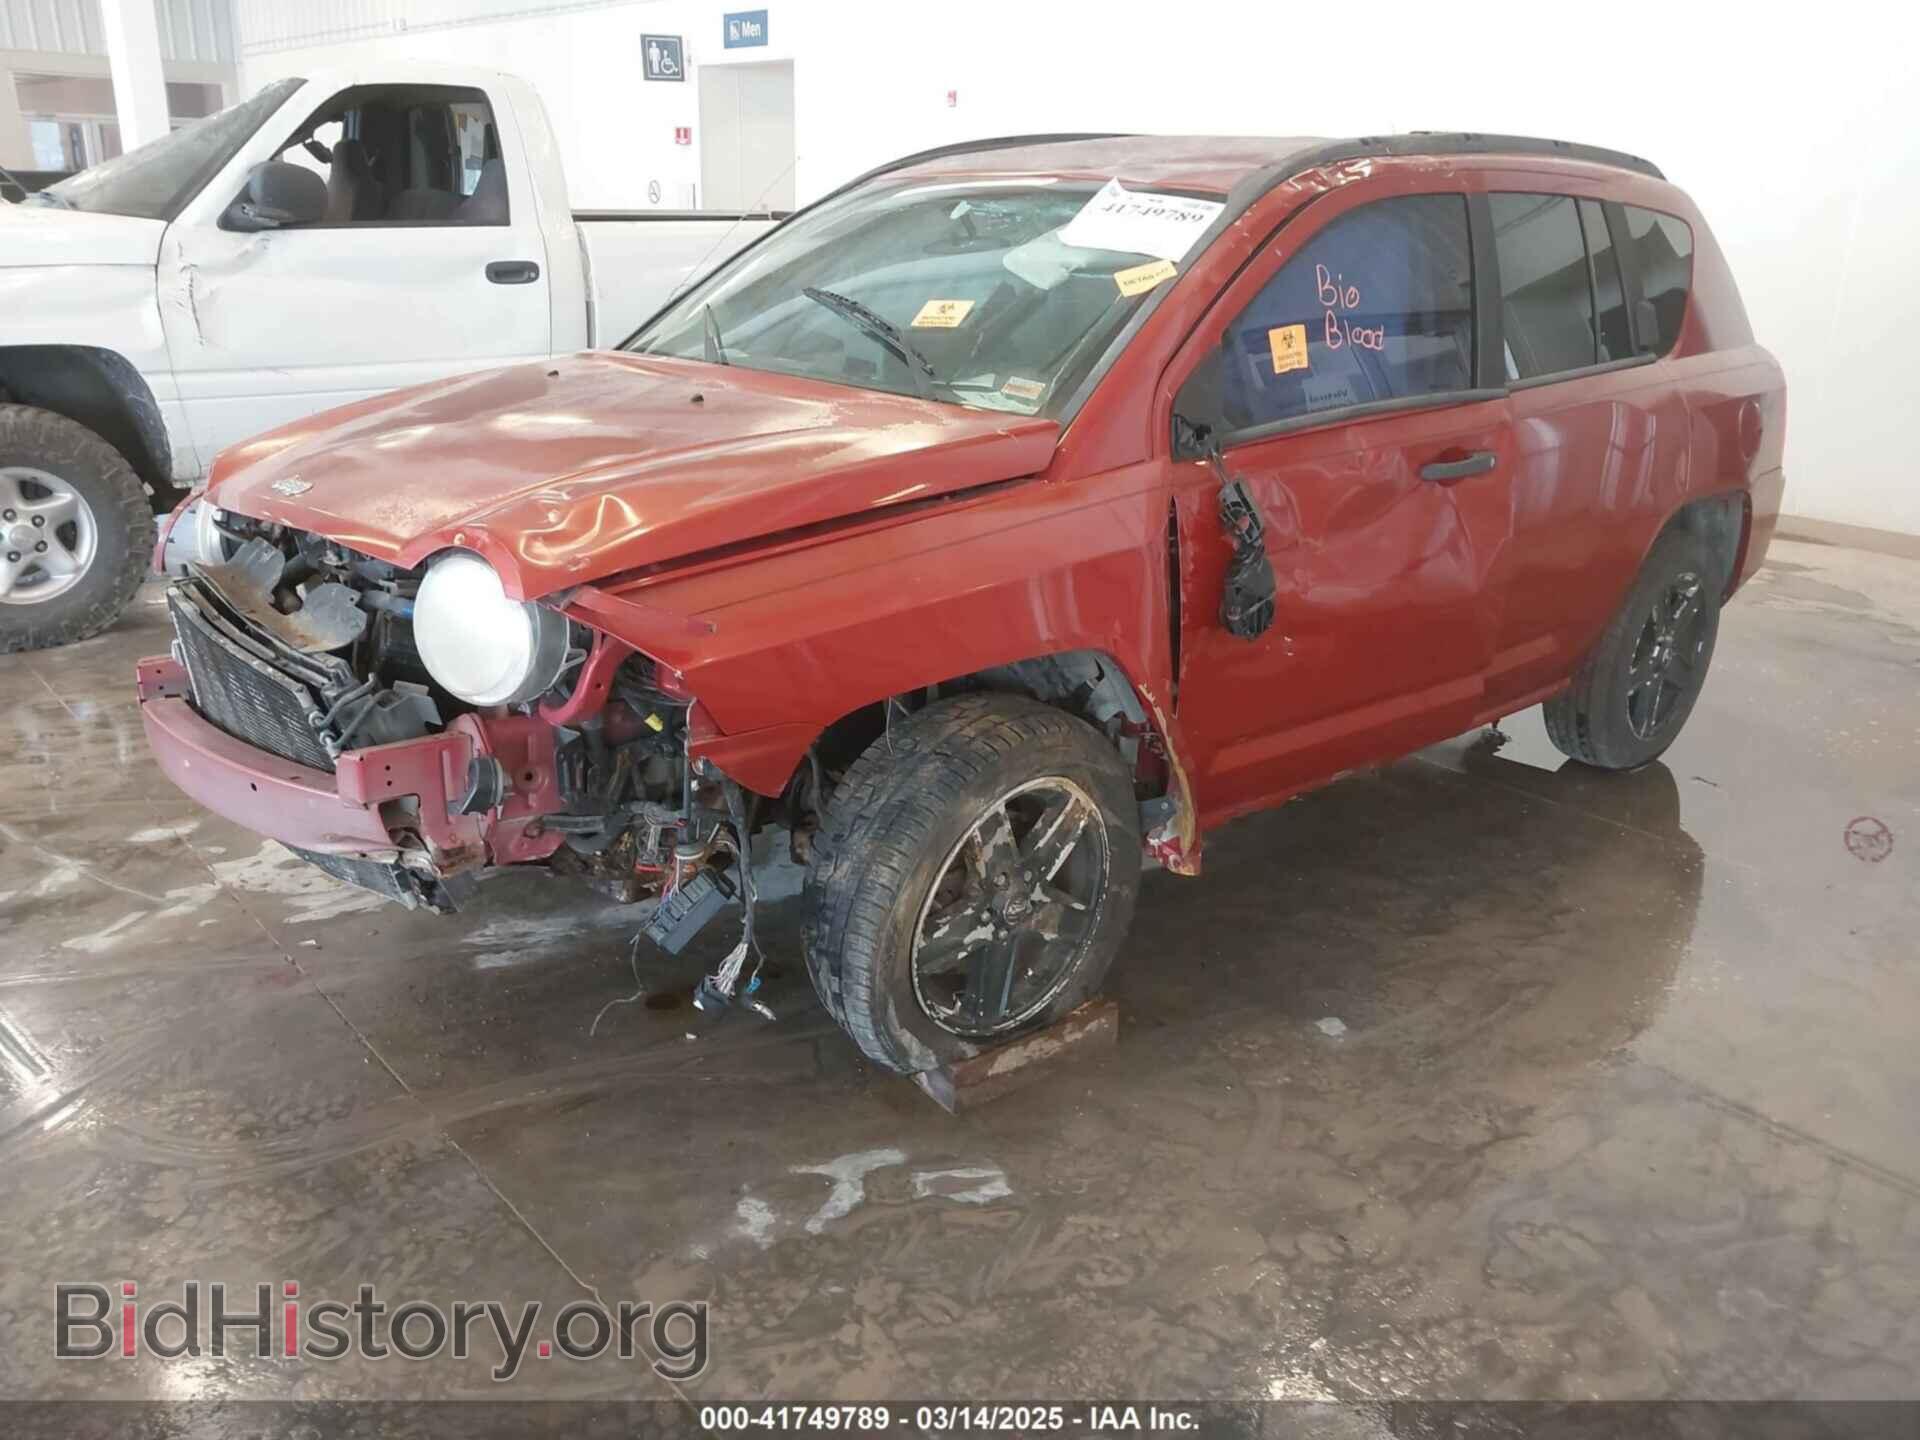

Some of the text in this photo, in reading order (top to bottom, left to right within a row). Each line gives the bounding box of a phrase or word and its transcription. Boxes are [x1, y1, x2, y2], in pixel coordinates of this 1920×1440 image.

[741, 20, 761, 39] Men
[1101, 203, 1205, 222] 41749789
[1316, 264, 1360, 309] Bio
[1325, 310, 1385, 350] Blood
